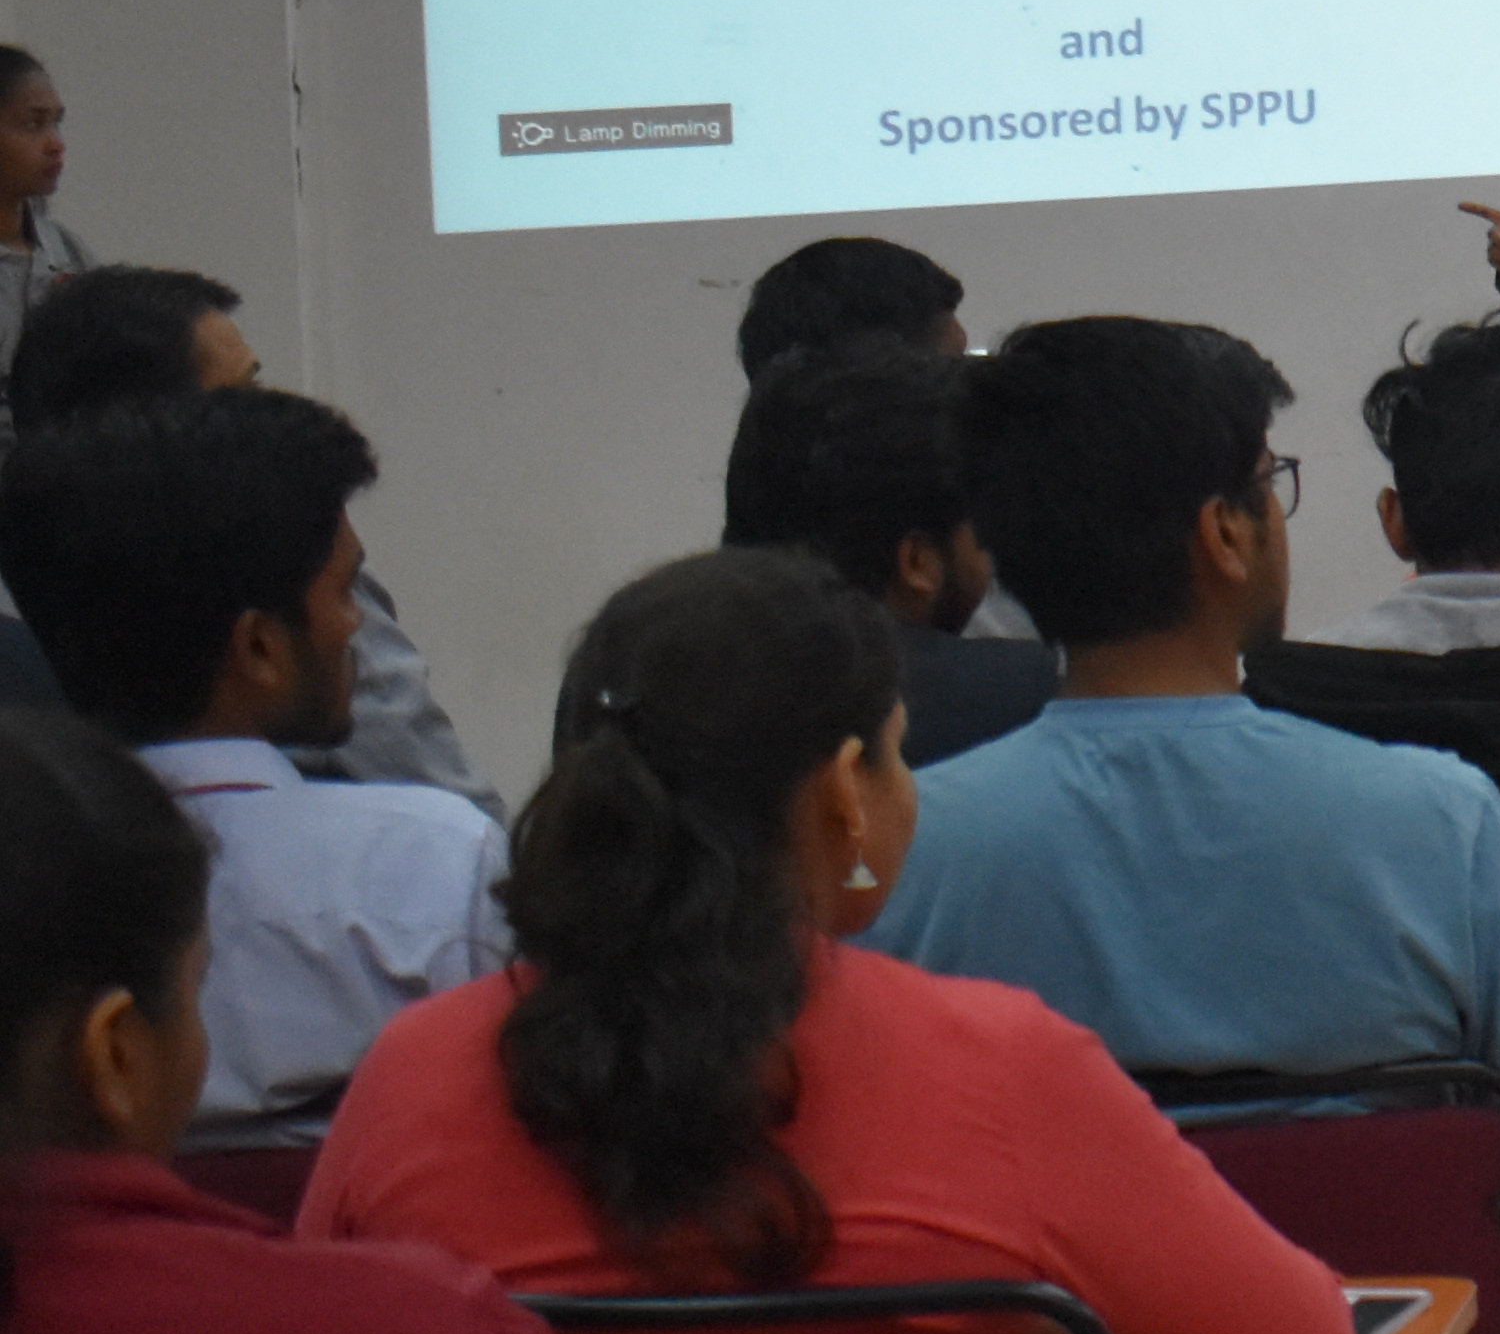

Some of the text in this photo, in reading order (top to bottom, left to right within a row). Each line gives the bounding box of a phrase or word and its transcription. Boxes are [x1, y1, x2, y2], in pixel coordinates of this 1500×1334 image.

[1059, 18, 1145, 61] and
[563, 114, 721, 151] Lamp Dimming
[877, 86, 1317, 155] Sponsored by SPPU
